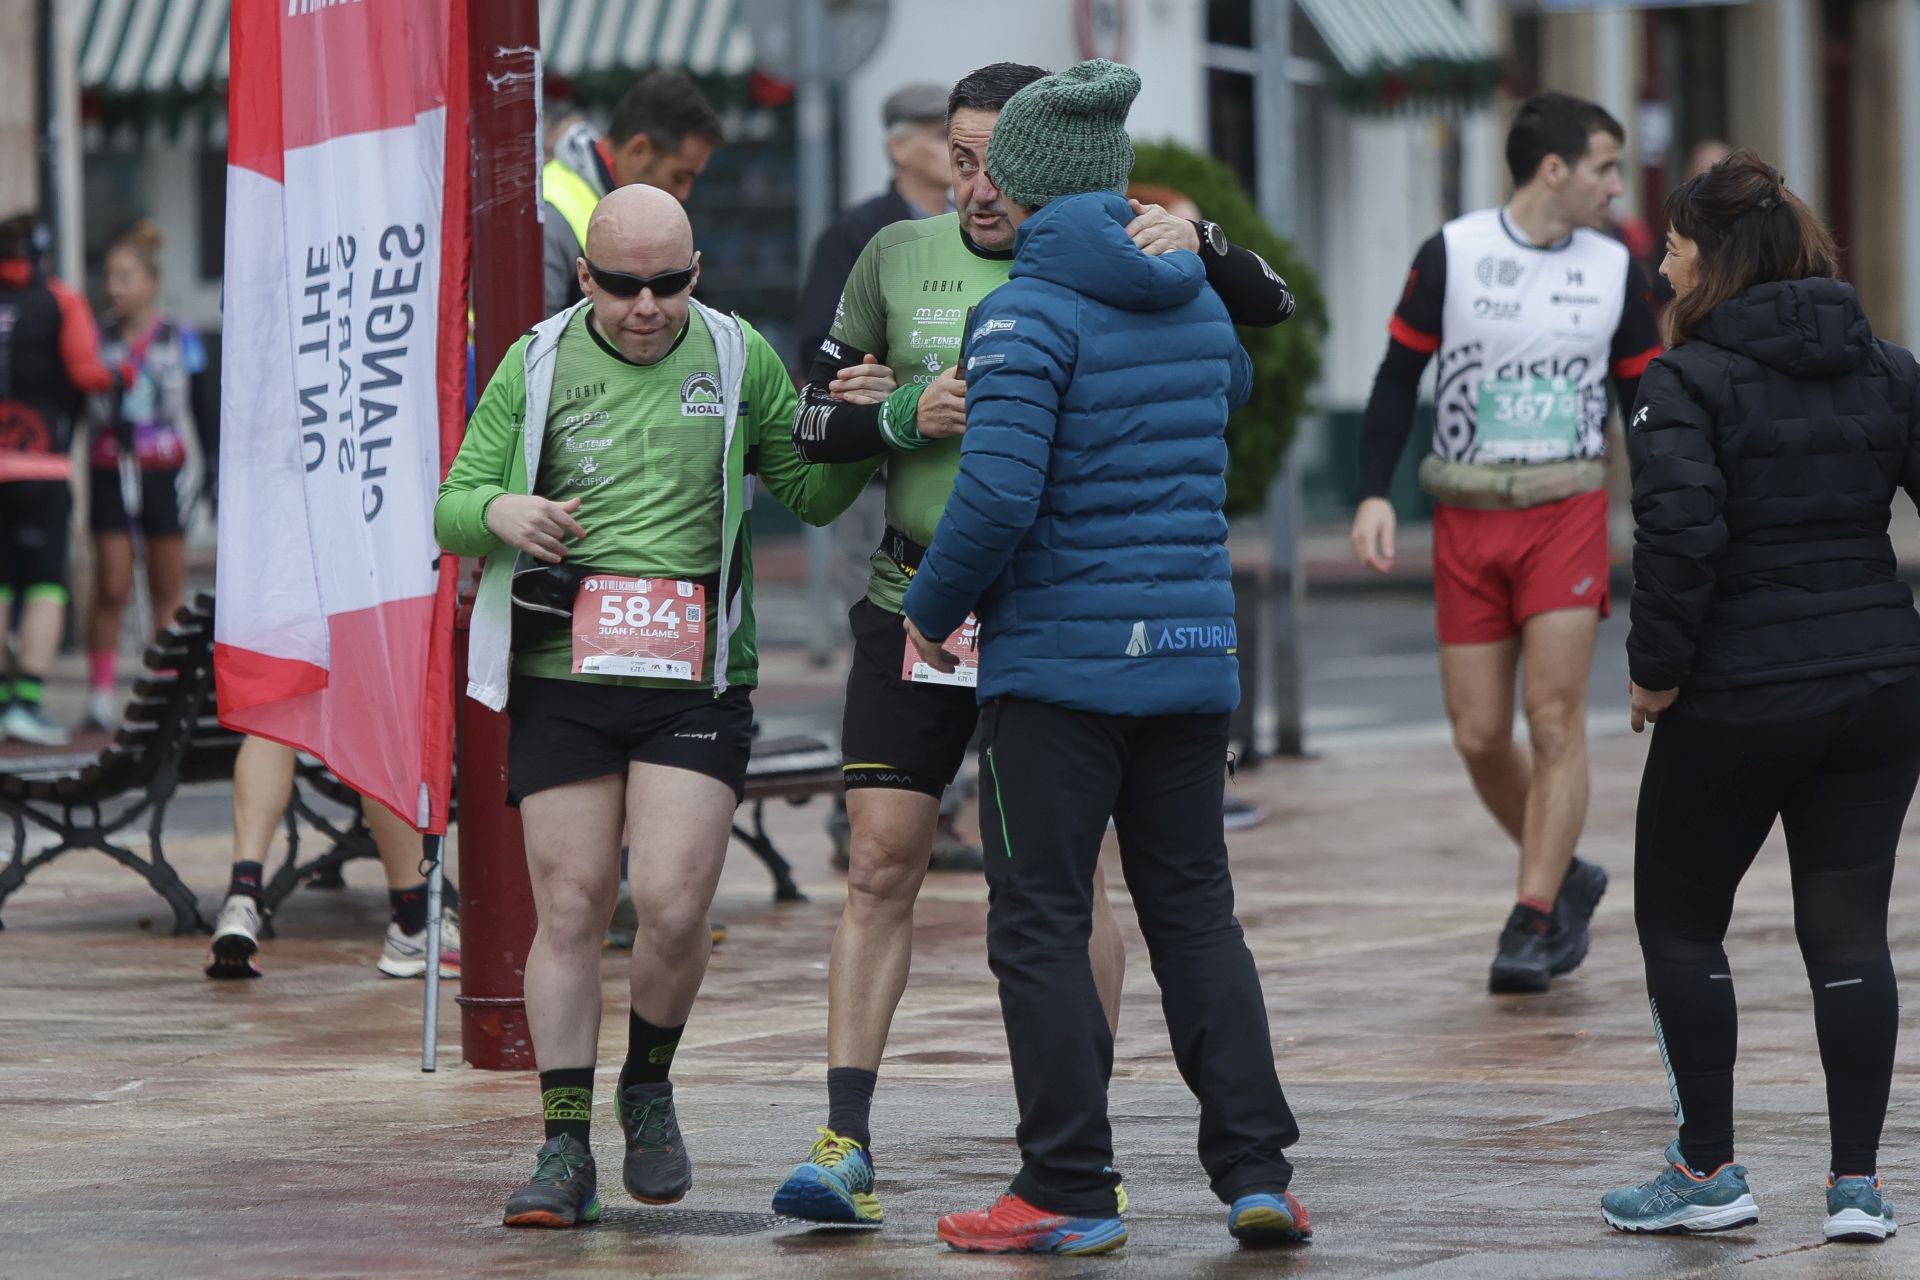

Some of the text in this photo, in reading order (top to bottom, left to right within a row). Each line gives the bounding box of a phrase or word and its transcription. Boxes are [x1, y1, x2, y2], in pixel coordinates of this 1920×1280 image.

[922, 280, 963, 293] GOBIK
[565, 382, 607, 400] GOBIK
[686, 405, 720, 415] MOAL
[1494, 393, 1555, 422] 367
[599, 595, 680, 629] 584
[599, 627, 627, 635] JUAN
[629, 627, 638, 635] F.
[640, 628, 679, 639] LLAMES
[547, 1111, 589, 1119] MOAL
